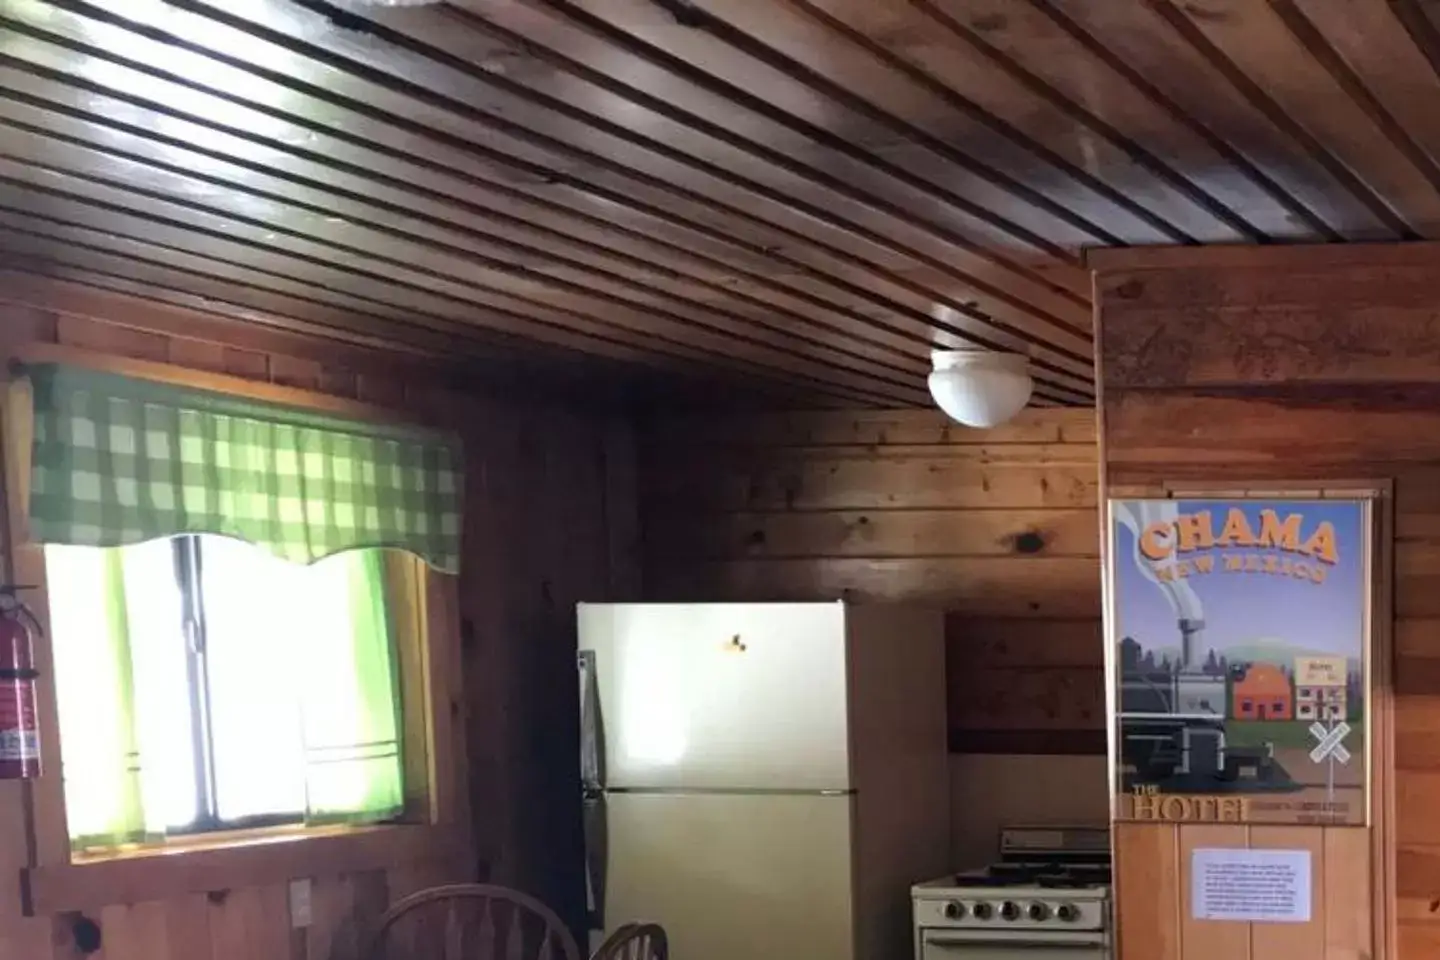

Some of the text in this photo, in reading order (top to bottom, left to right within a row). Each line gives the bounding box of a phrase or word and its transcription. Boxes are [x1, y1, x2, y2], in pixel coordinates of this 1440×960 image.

[1140, 508, 1339, 566] CHAMA
[1155, 553, 1328, 585] NEW MEXICO
[1132, 796, 1251, 822] HOTEL
